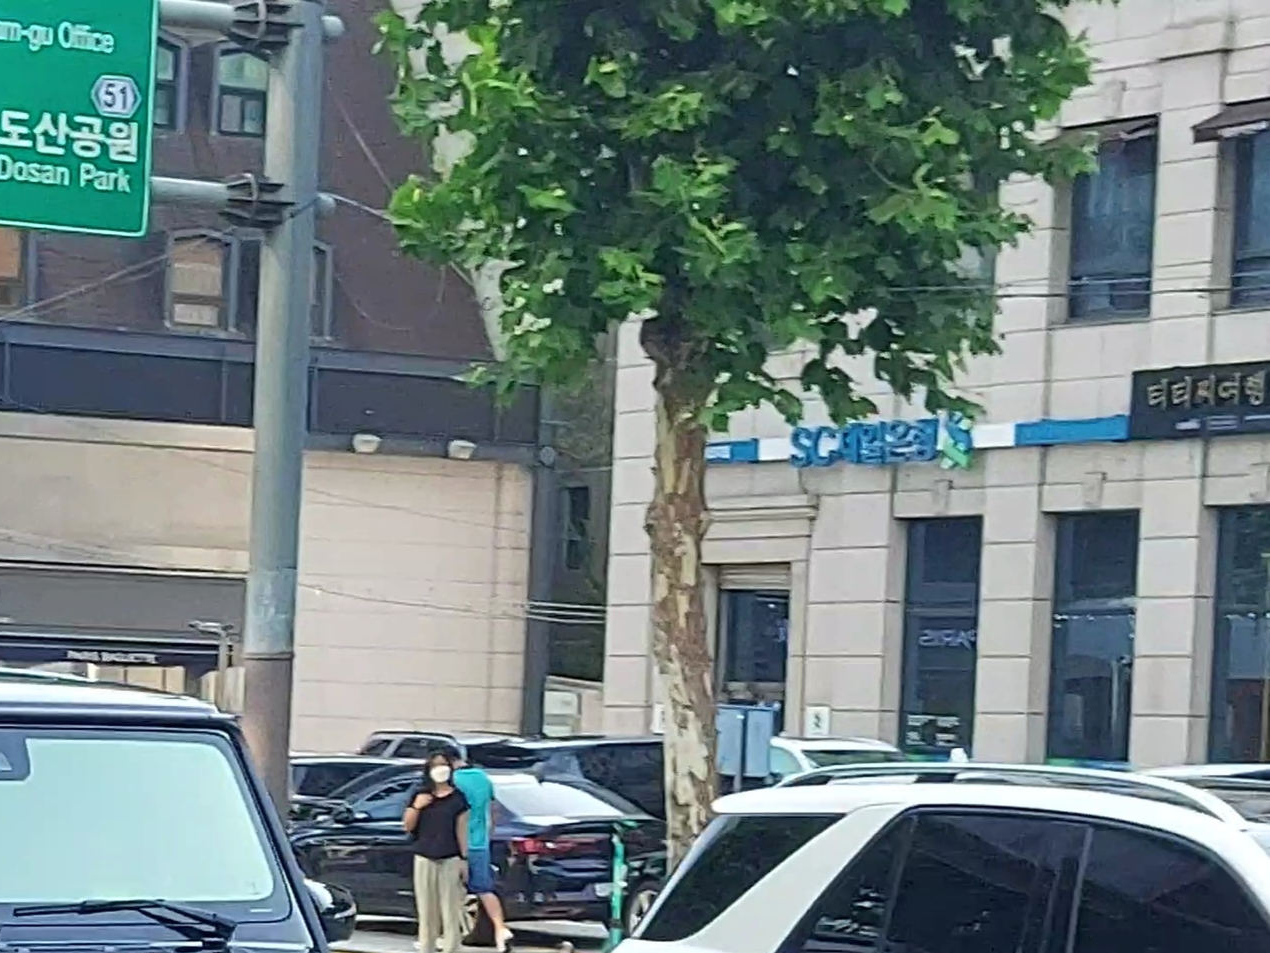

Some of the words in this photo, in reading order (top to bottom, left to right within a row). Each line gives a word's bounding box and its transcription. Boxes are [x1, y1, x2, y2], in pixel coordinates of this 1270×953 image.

[57, 21, 115, 54] Office
[103, 82, 129, 111] 51
[80, 162, 131, 194] Park
